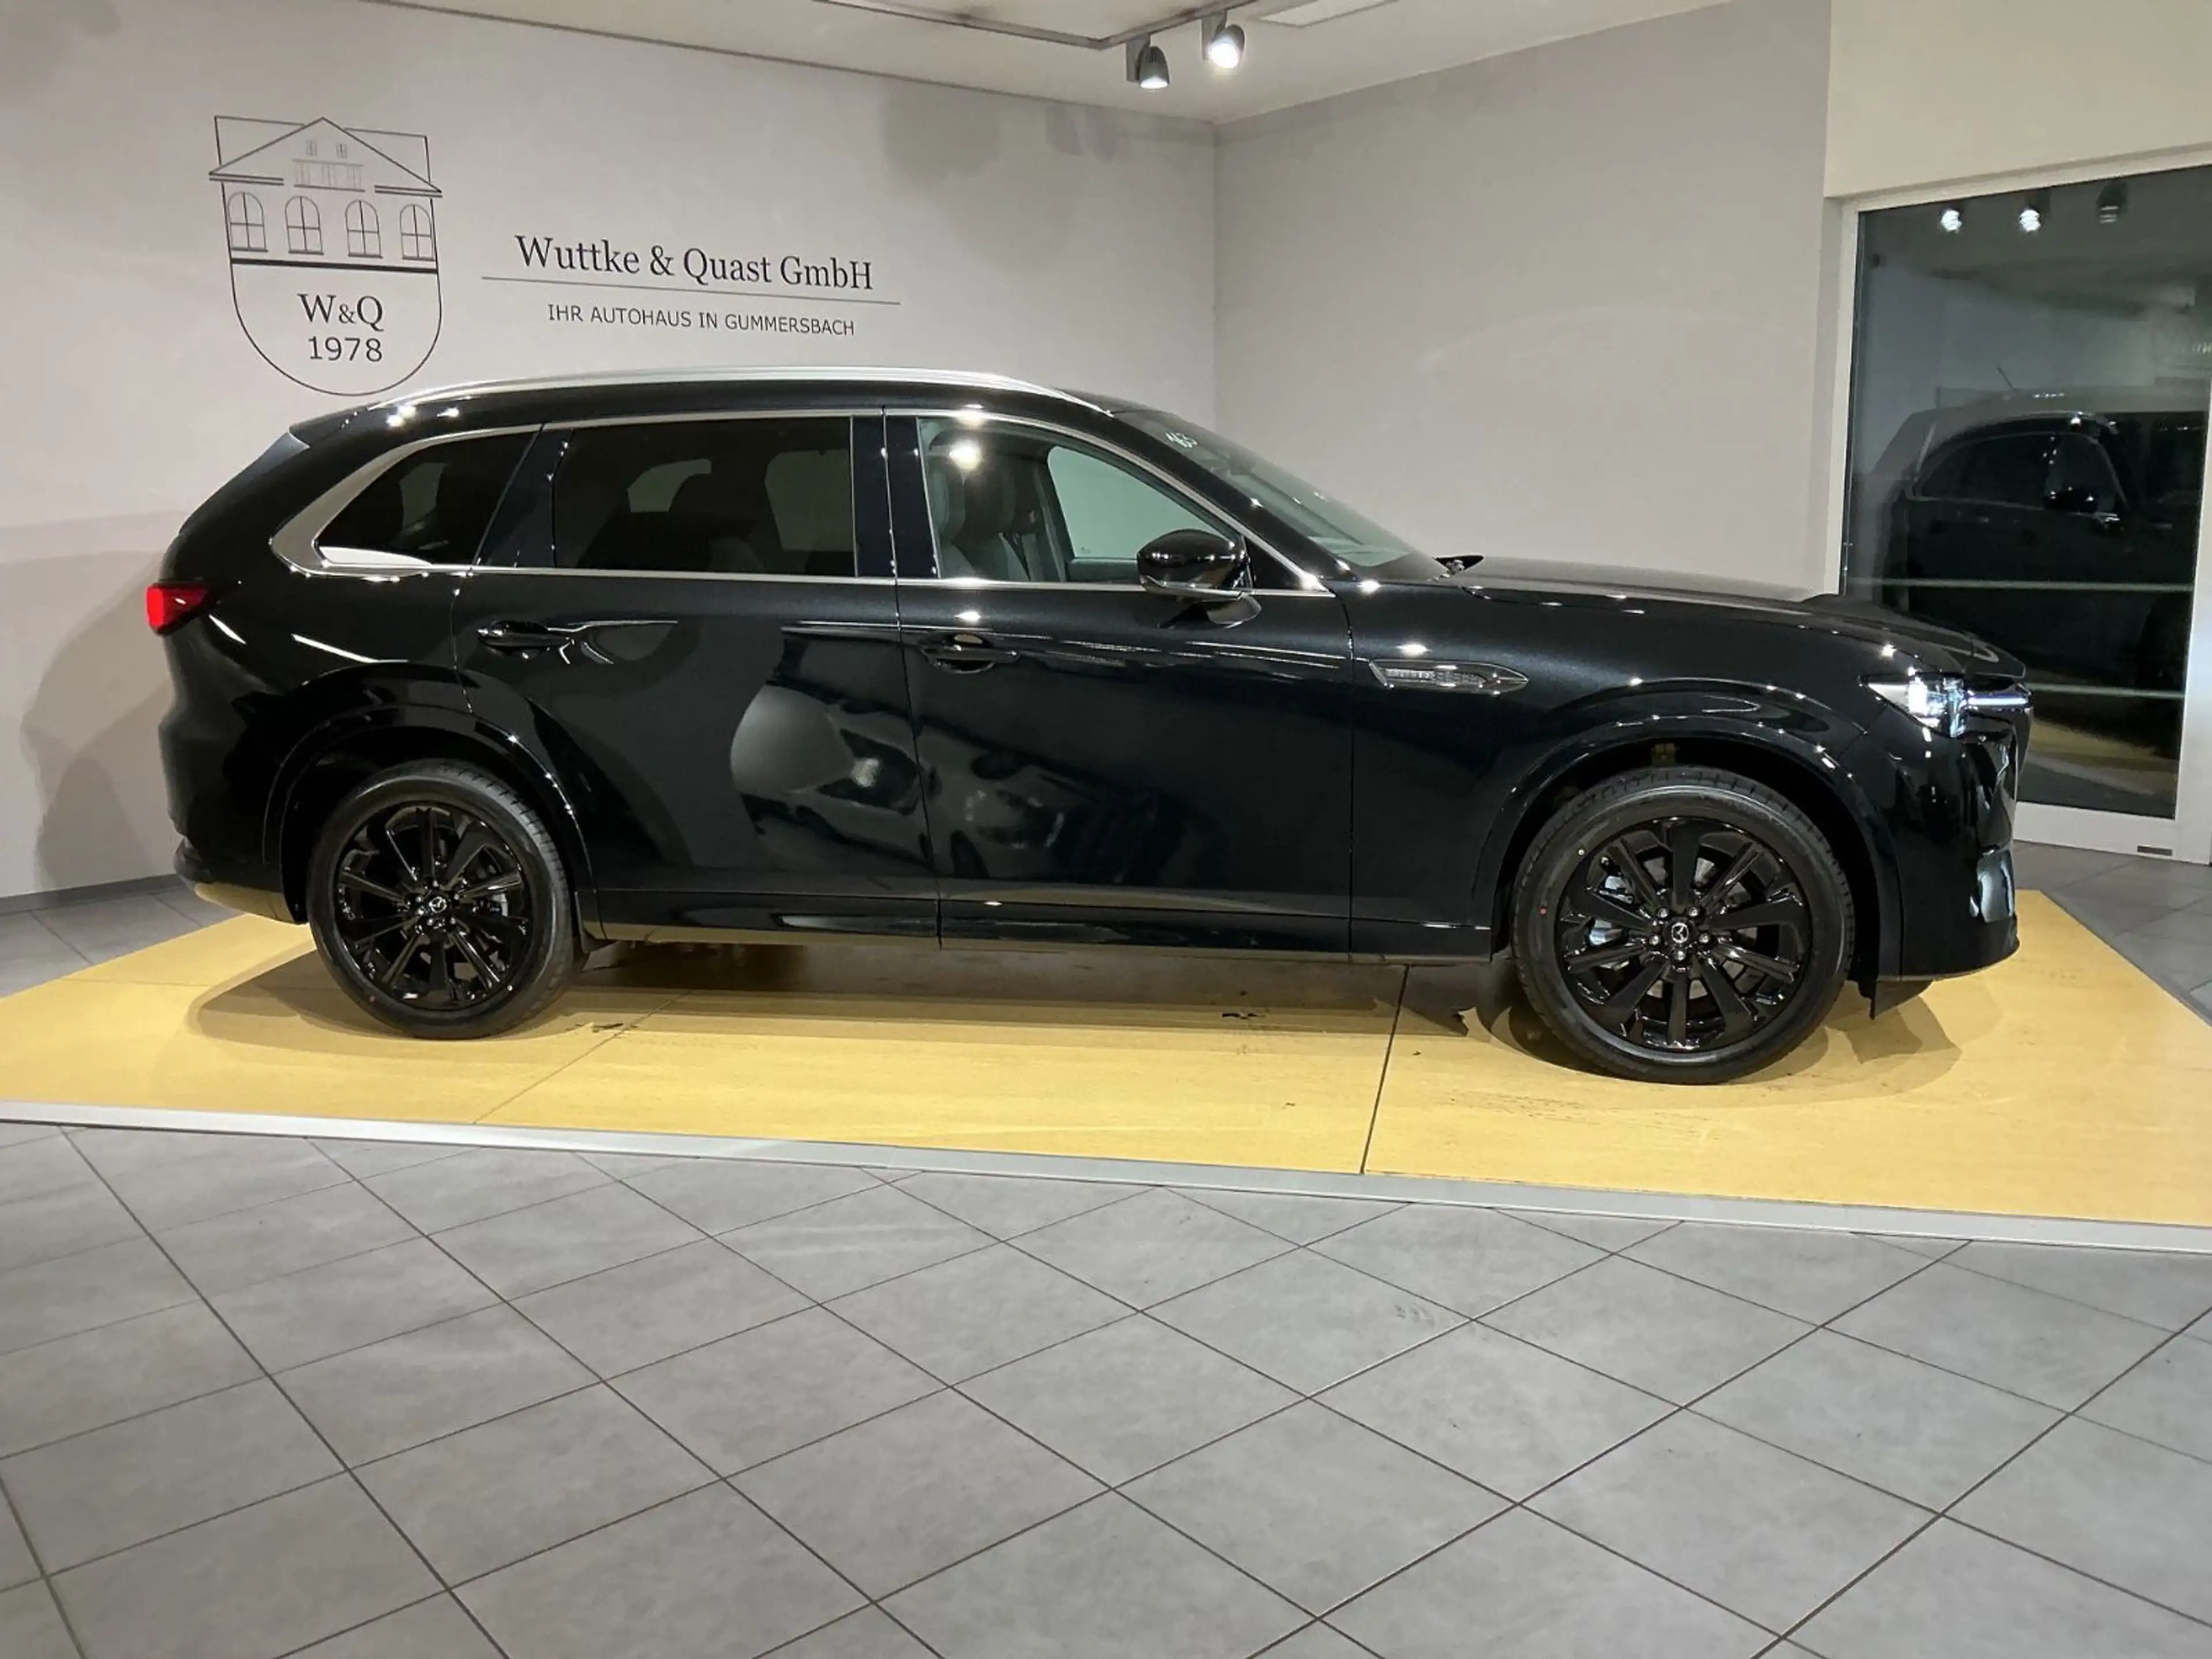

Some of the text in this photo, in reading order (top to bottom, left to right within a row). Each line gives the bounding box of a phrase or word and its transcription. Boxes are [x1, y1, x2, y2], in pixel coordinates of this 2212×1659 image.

[514, 234, 874, 291] Wuttke & Quast GmbH
[297, 293, 384, 329] W&Q
[548, 304, 855, 336] IHR AUTOHAUS IN GUMMERSBACH
[308, 335, 383, 363] 1978
